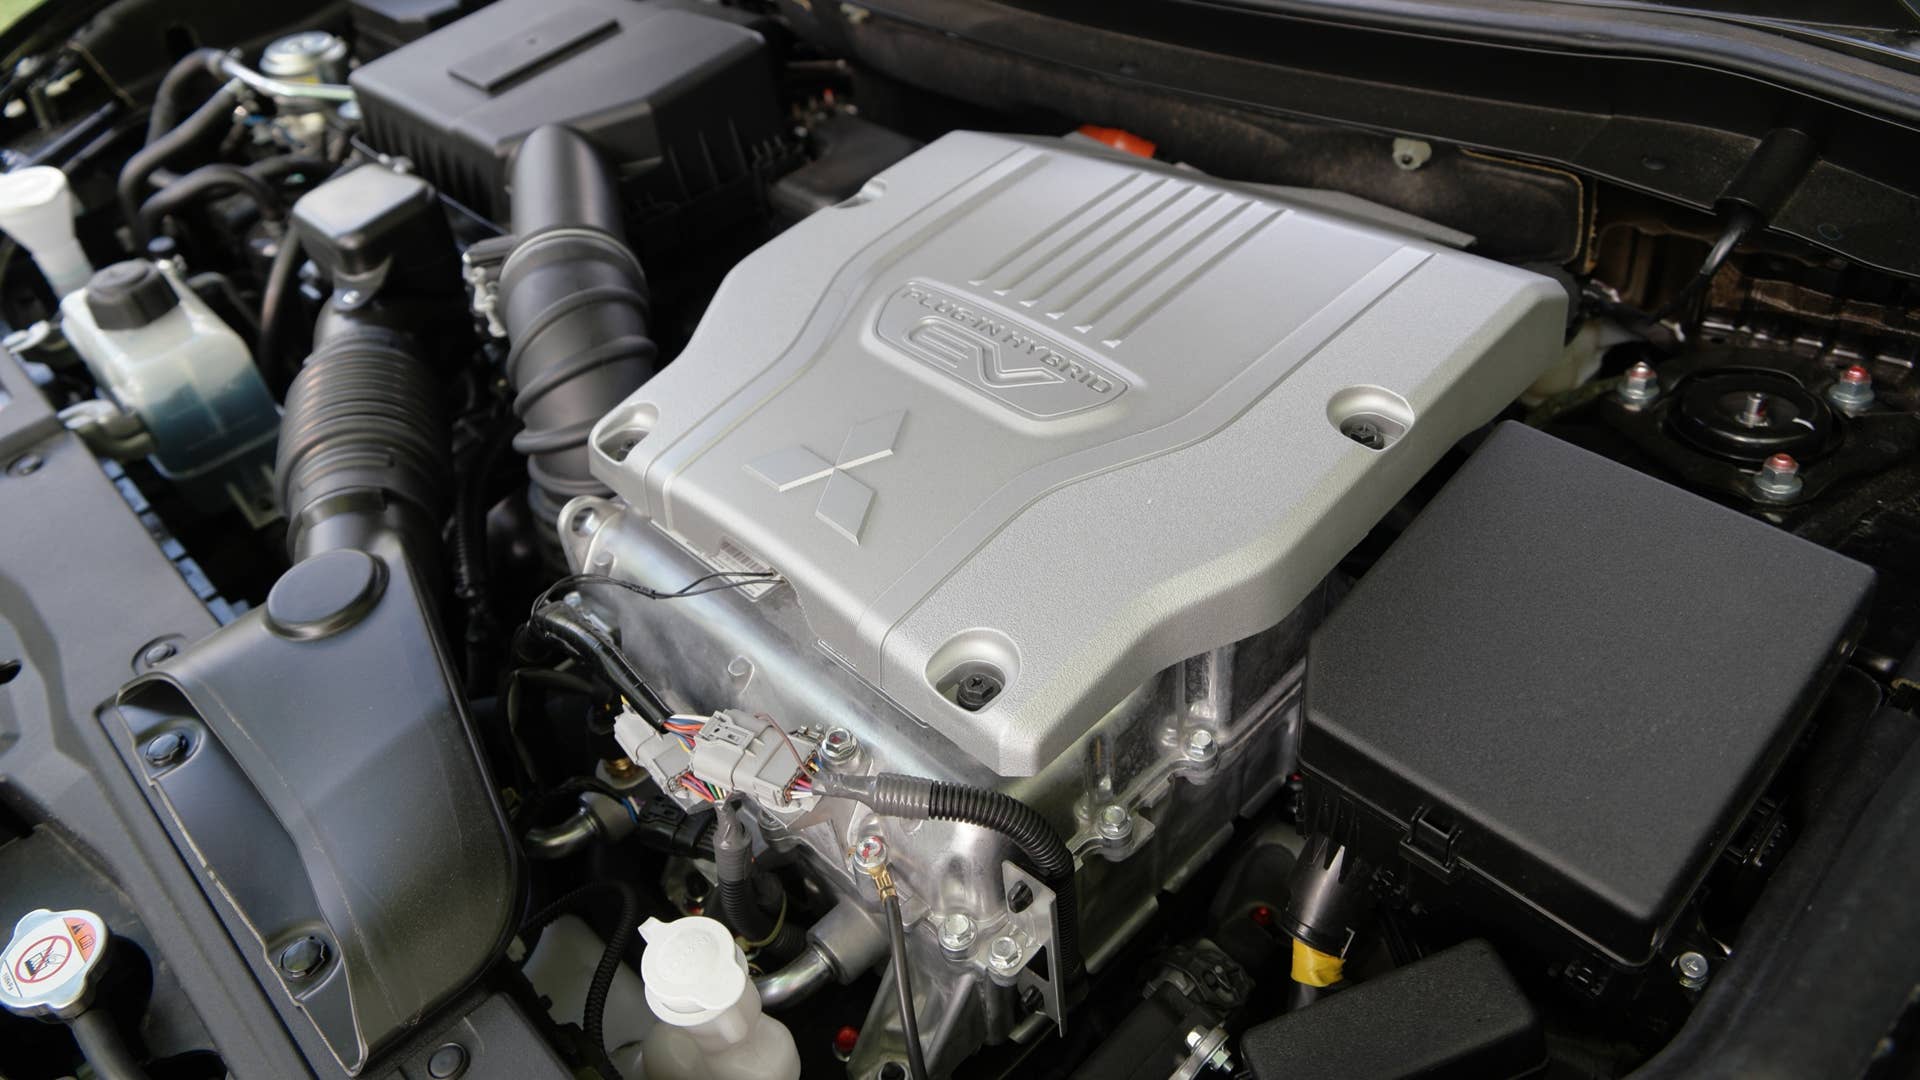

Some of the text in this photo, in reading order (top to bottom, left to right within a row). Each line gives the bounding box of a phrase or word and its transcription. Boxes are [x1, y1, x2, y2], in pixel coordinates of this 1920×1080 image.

[902, 287, 1113, 394] PLUG-IN HYBRID
[903, 314, 1067, 389] EV
